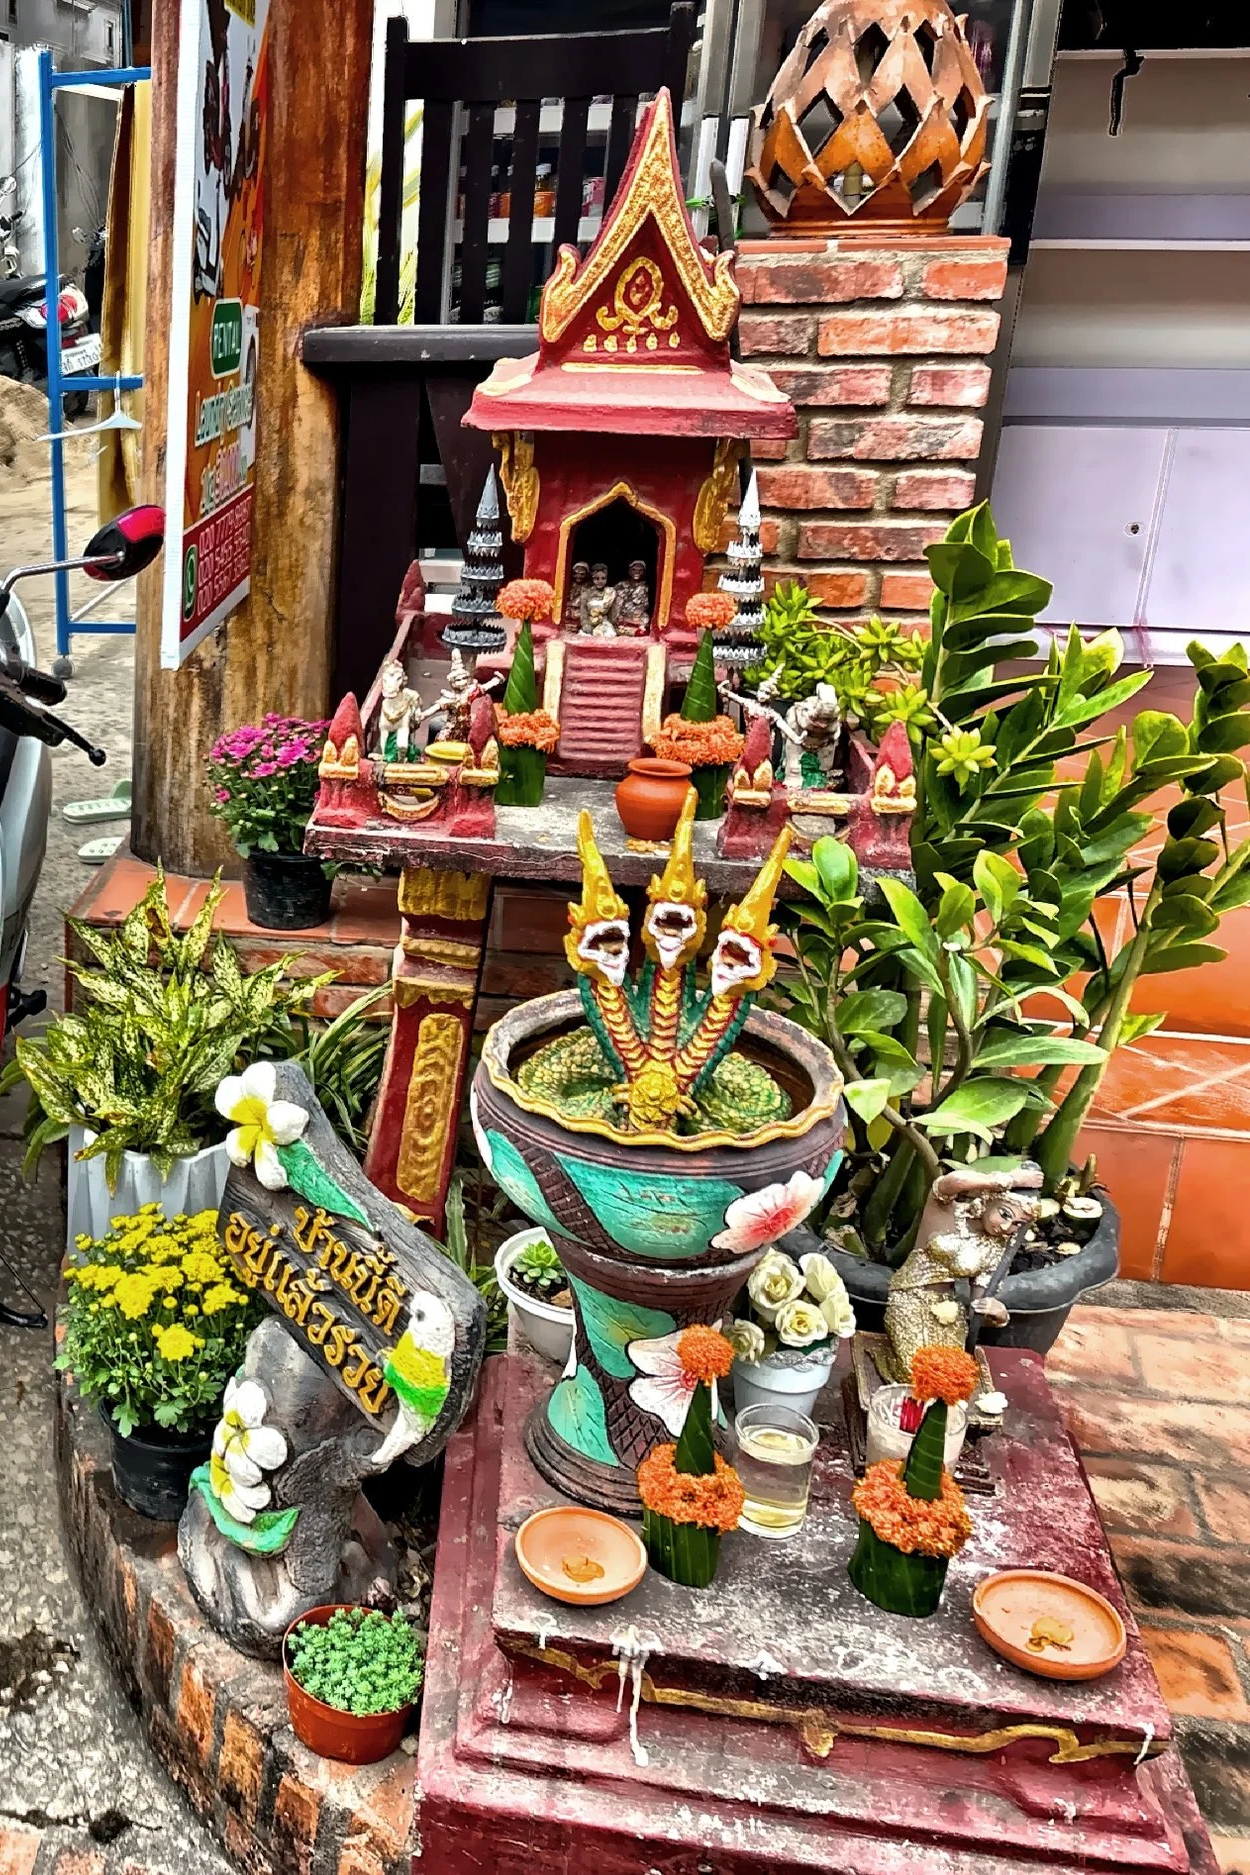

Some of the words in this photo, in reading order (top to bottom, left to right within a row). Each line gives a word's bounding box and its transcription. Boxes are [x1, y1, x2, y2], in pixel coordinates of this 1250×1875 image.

[224, 1211, 390, 1414] อยู่แล้วรวย
